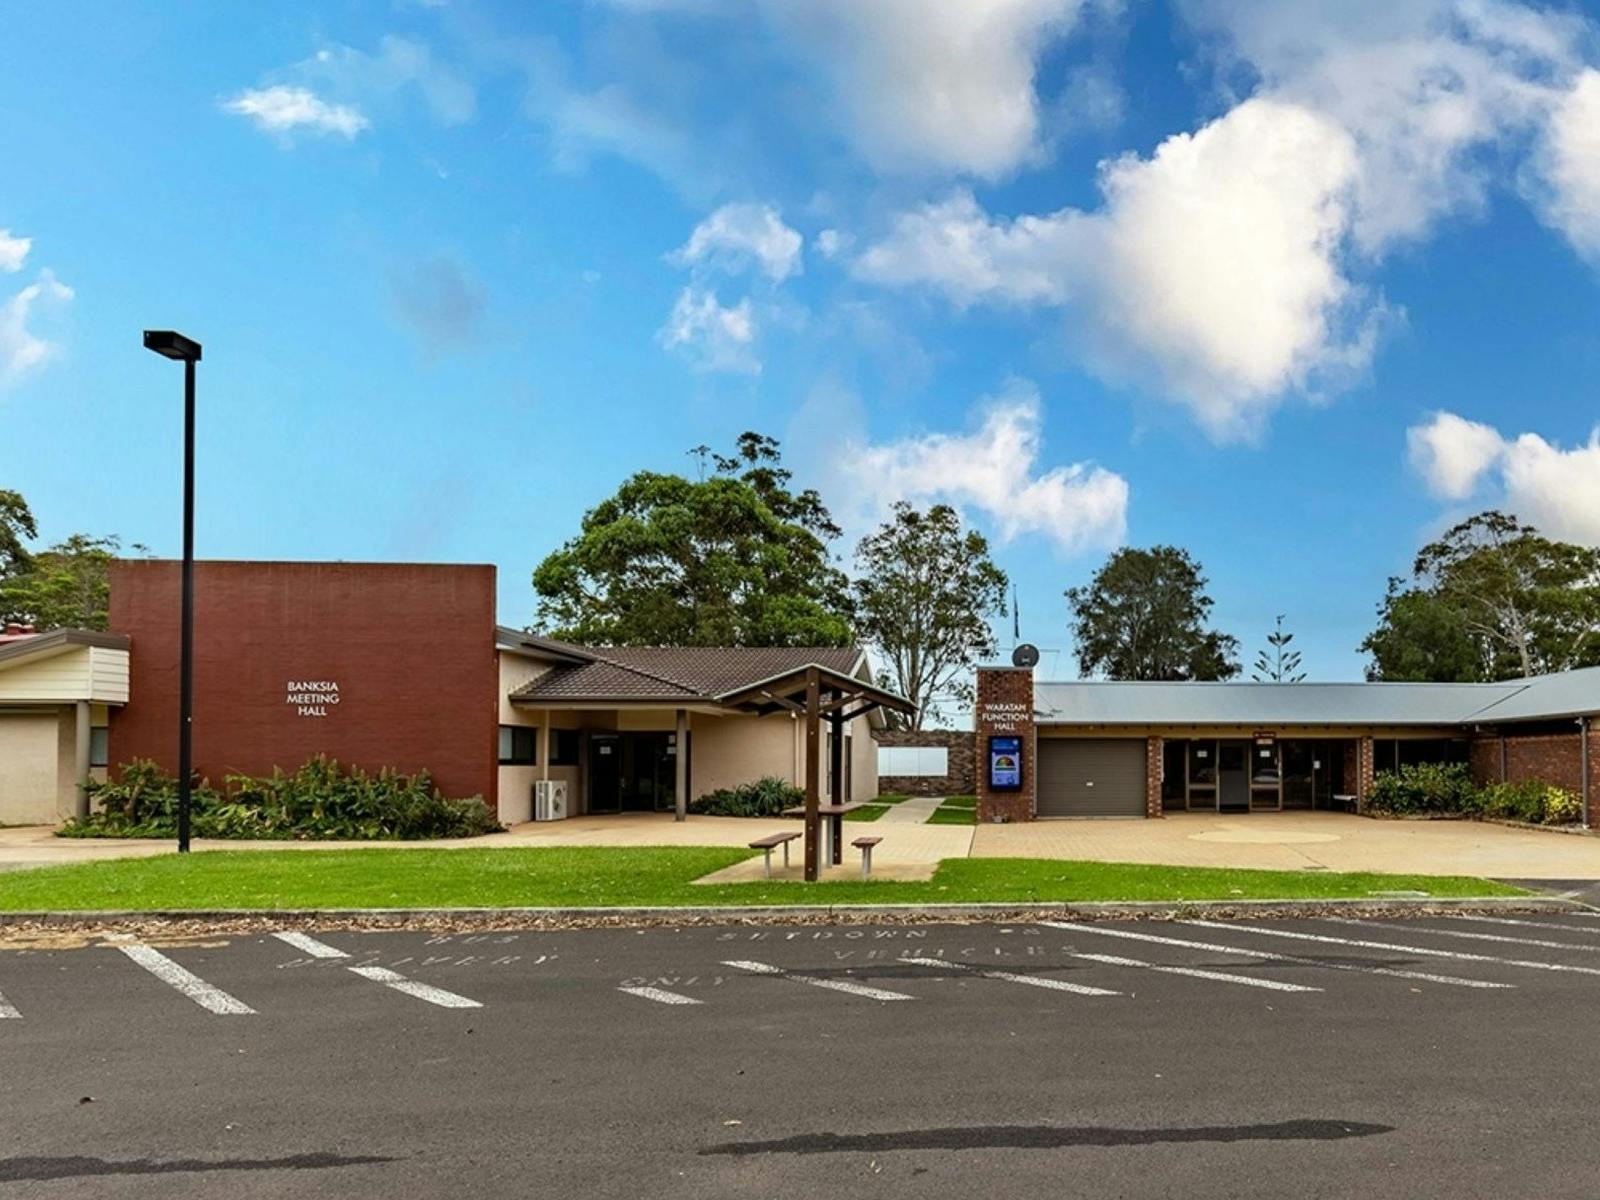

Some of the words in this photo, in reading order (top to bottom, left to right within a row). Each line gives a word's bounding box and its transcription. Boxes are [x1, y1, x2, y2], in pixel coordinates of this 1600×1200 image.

[287, 681, 339, 692] BANKSIA
[287, 694, 340, 704] MEETING
[298, 706, 327, 716] HALL
[985, 703, 1026, 711] WARATAH
[982, 713, 1028, 721] FUNCTION
[994, 722, 1016, 730] HALL
